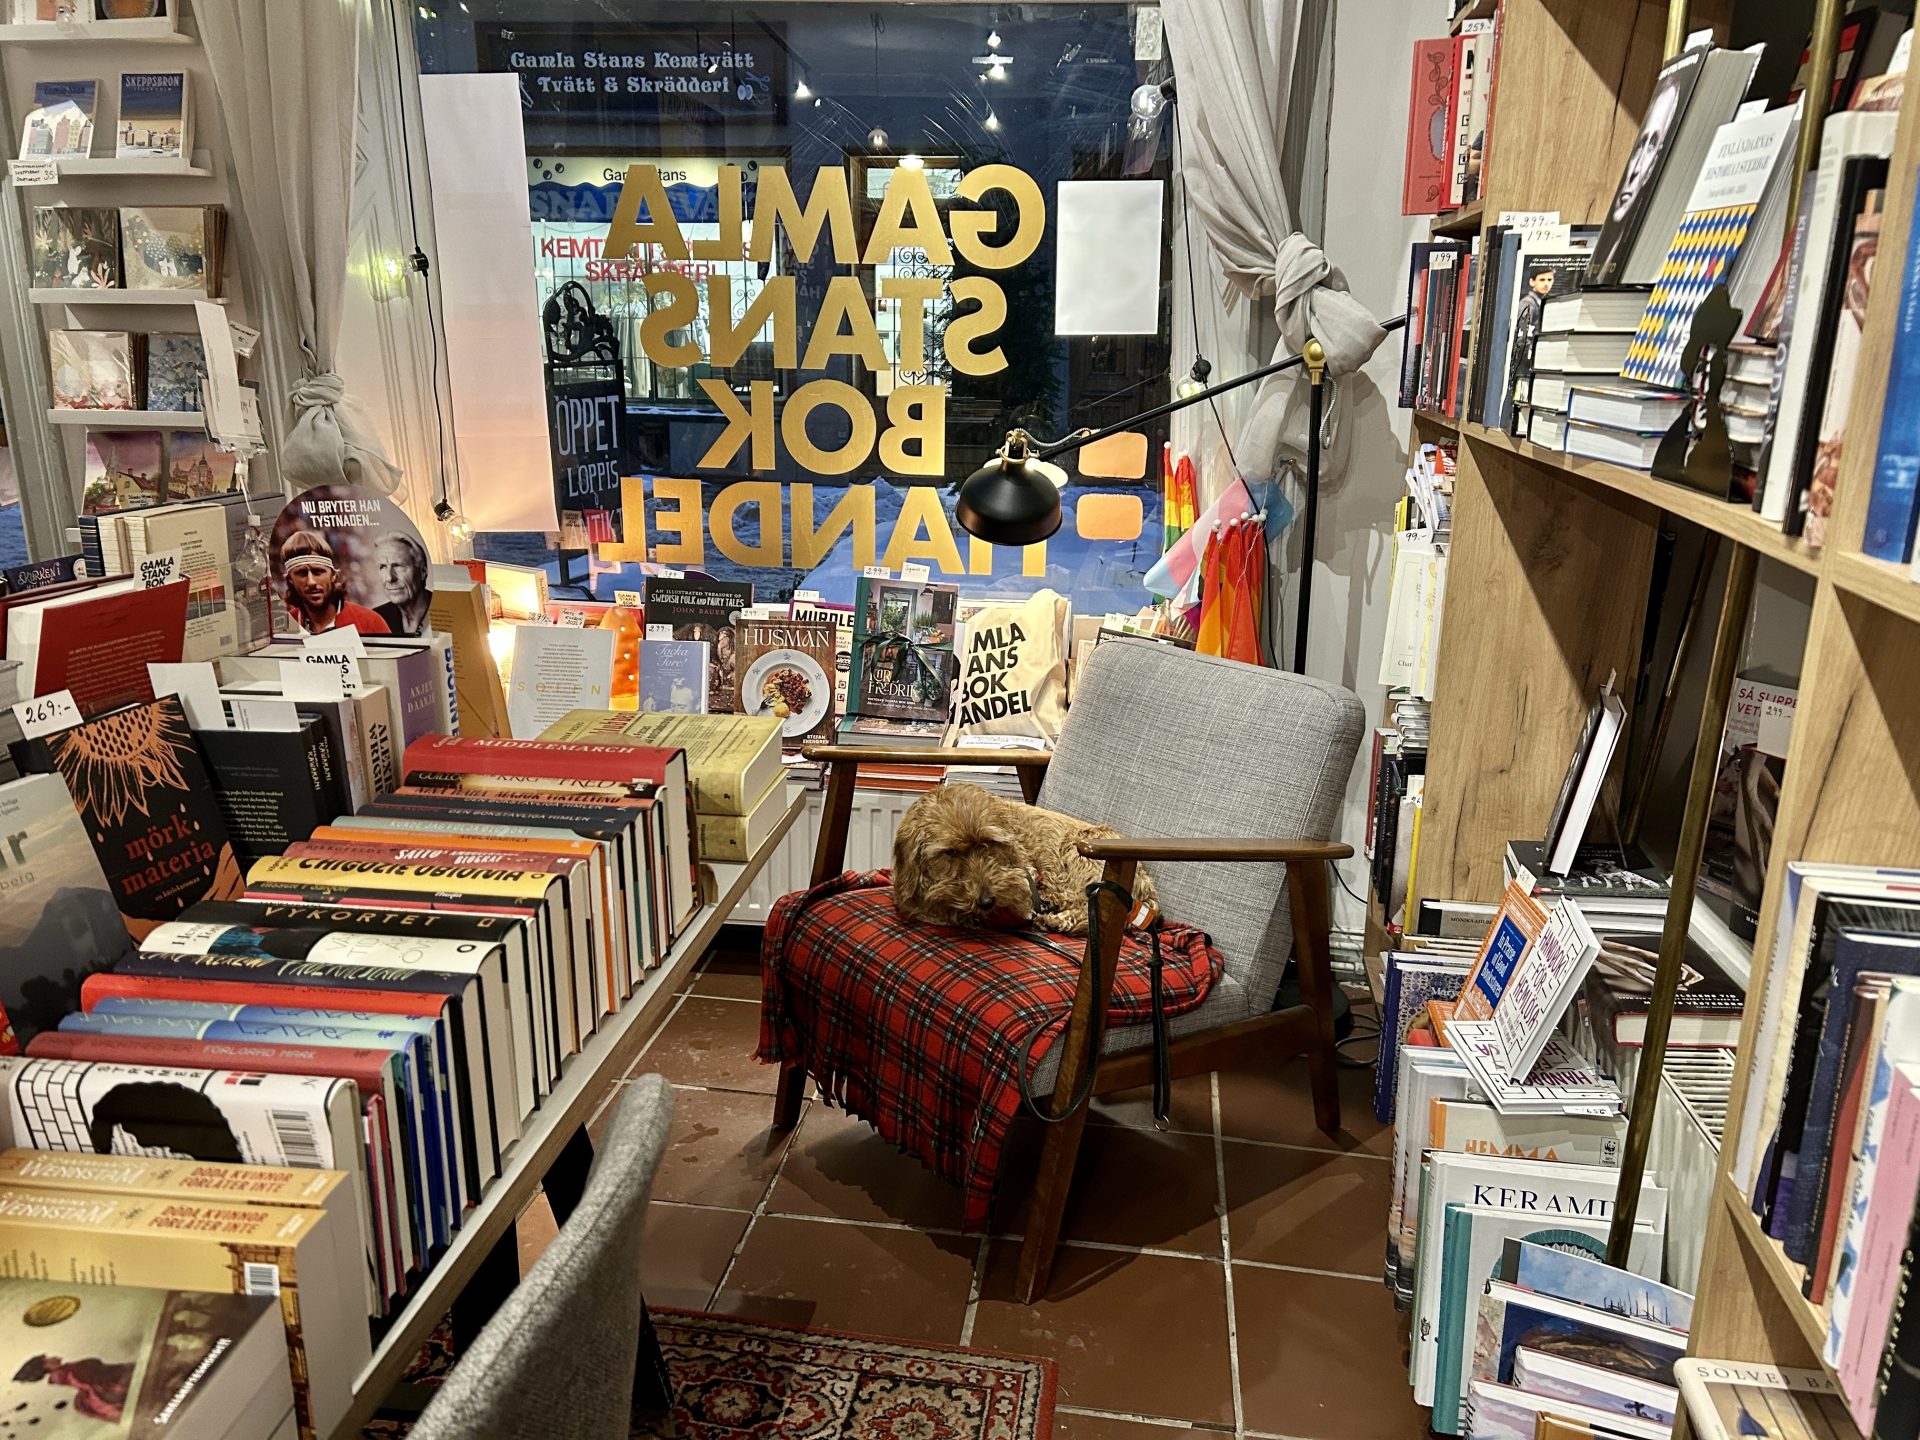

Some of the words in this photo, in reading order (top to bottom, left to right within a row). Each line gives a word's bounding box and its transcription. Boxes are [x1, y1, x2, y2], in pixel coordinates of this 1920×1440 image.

[510, 51, 575, 68] Gamla
[584, 52, 645, 68] Stans
[654, 51, 754, 70] Kemtvätt
[125, 76, 180, 87] SKEPPSBRON
[538, 76, 595, 93] Tvätt
[605, 77, 618, 92] &
[627, 76, 729, 93] Skrädderi
[658, 169, 687, 181] tans
[1792, 215, 1808, 260] Klaus
[554, 394, 620, 457] ÖPPET
[301, 501, 315, 514] NU
[318, 500, 357, 514] BRYTER
[360, 499, 381, 512] HAN
[310, 514, 380, 528] TYSTNADEN...
[140, 556, 175, 573] GAMLA
[141, 566, 171, 582] STANS
[145, 577, 166, 589] BOK
[651, 594, 679, 604] SWEDISH
[680, 595, 697, 605] FOLK
[706, 597, 724, 607] FAIRY
[725, 598, 744, 608] TALES
[699, 608, 725, 616] BAUER
[744, 628, 830, 648] HUSMAN
[968, 622, 1026, 654] MLA
[306, 654, 350, 664] GAMLA
[966, 646, 1019, 678] ANS
[1738, 687, 1755, 701] SÅ
[1737, 702, 1762, 718] VET
[474, 739, 636, 754] MIDDLEMARCH
[376, 722, 397, 795] ALEXIS
[473, 810, 545, 820] BOKSTAVLIGA
[124, 814, 192, 860] mörk
[121, 840, 215, 896] materia
[264, 906, 441, 927] VYKORTET
[1538, 926, 1567, 979] HANDBOK
[1465, 1138, 1559, 1161] HEMMA
[229, 1169, 293, 1183] KVINNOR
[247, 1181, 286, 1194] INTE
[202, 1208, 269, 1223] KVINNOR
[220, 1220, 261, 1235] INTE
[1697, 1365, 1790, 1387] SOLVEJ
